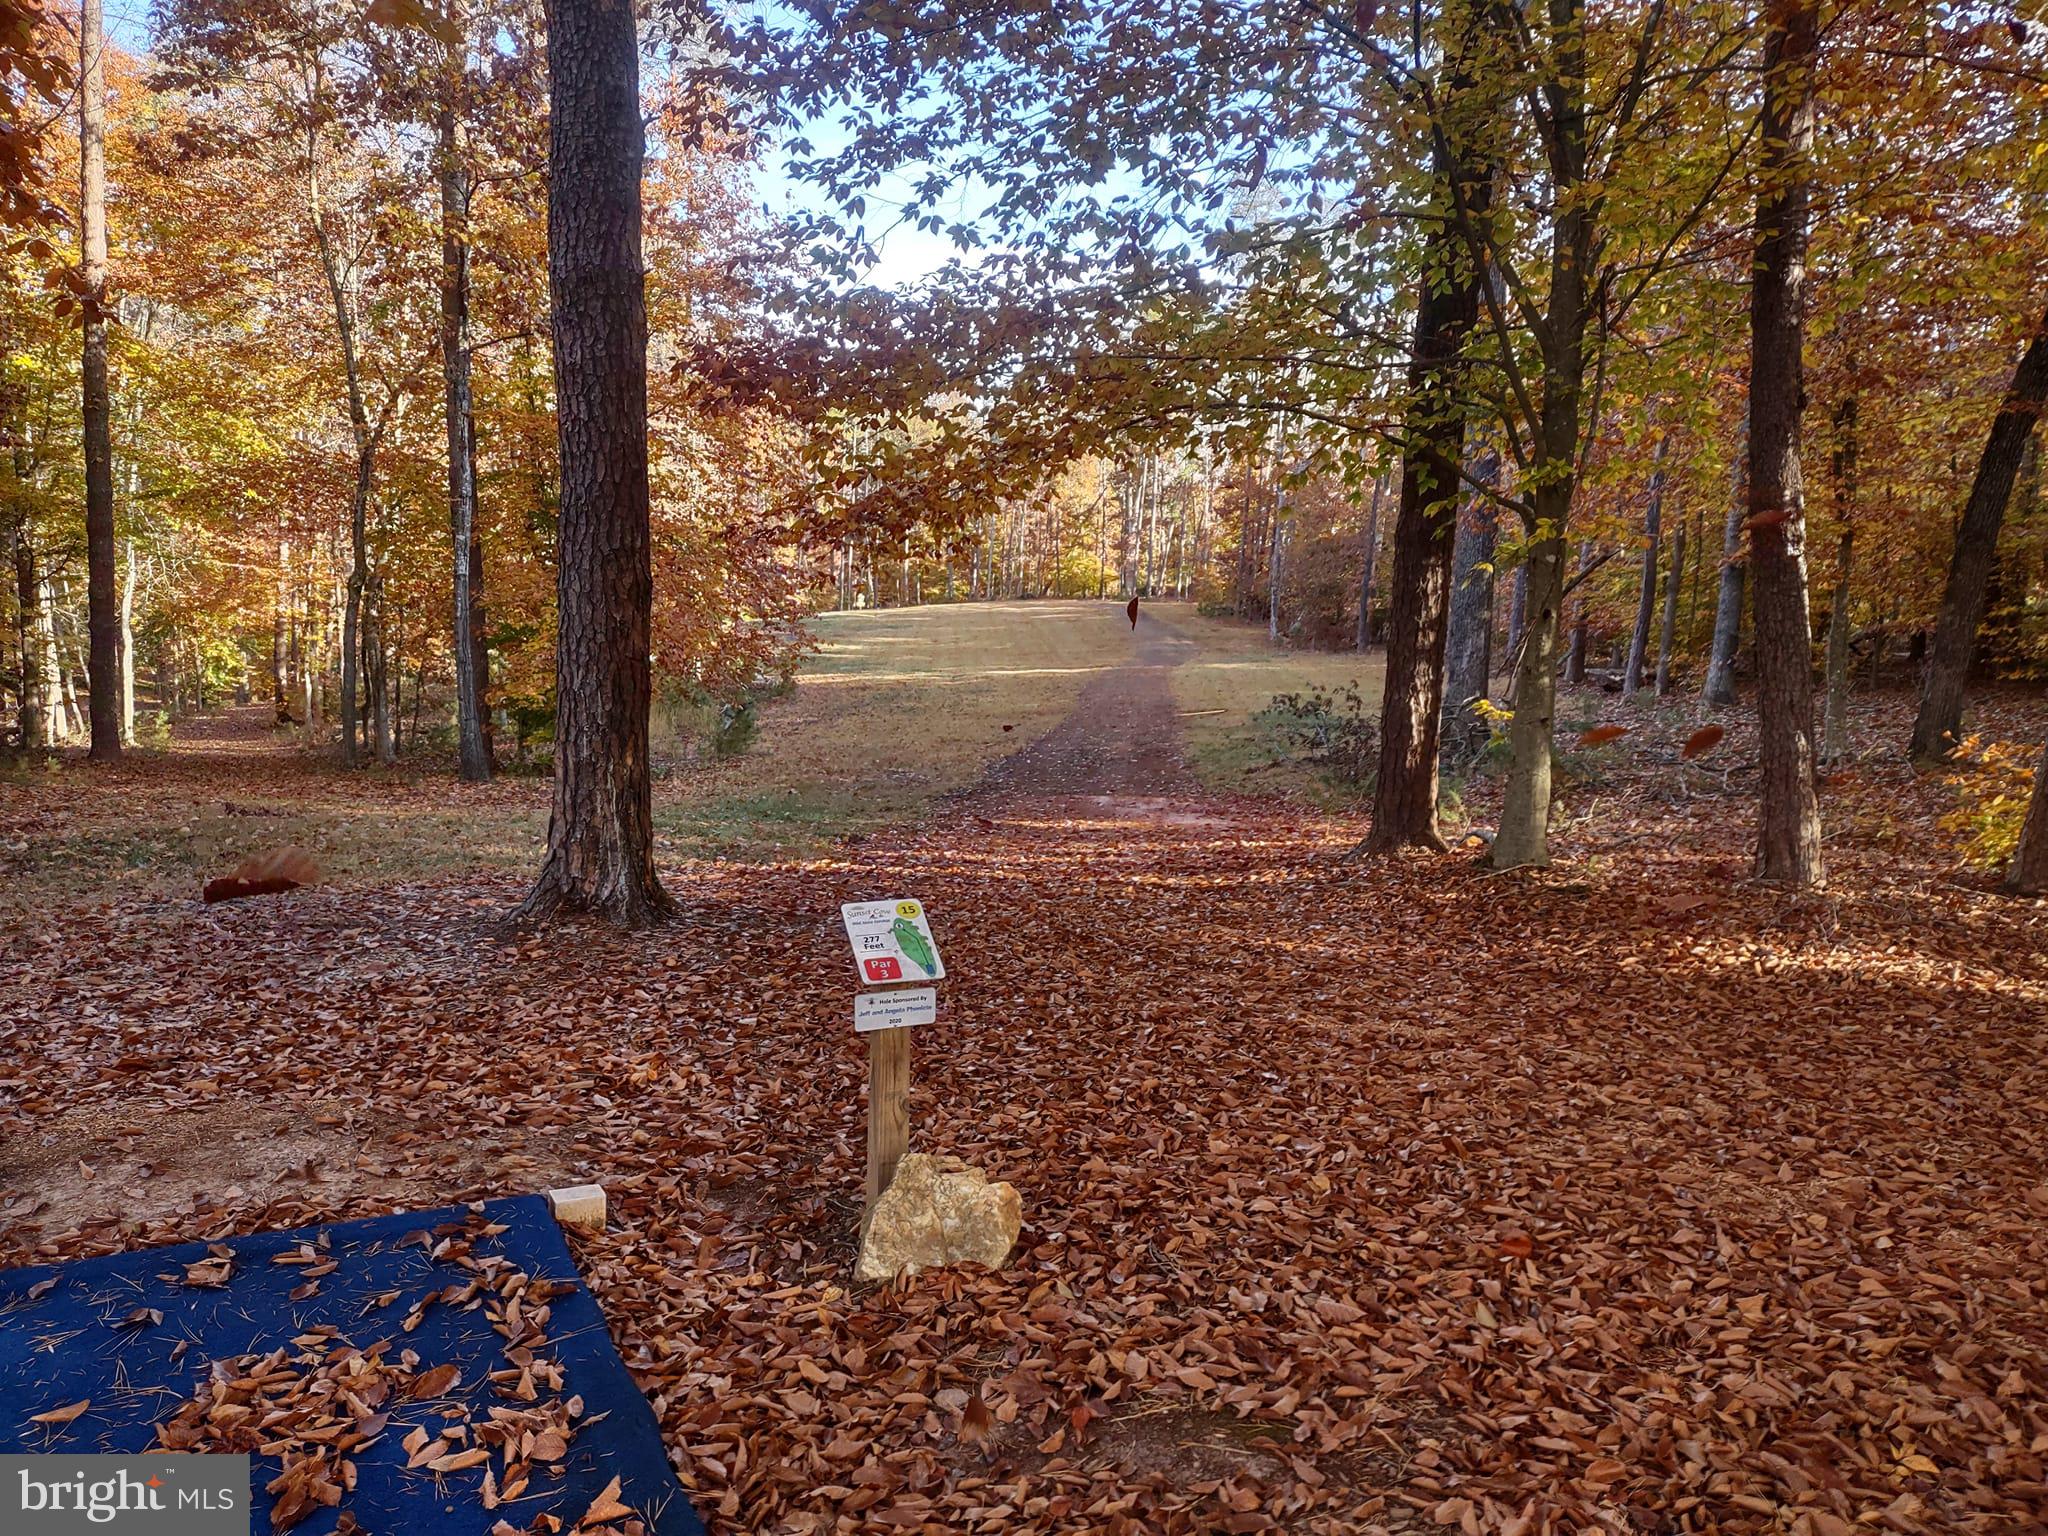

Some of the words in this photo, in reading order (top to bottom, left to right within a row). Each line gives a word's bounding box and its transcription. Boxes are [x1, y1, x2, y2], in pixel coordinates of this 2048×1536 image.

[846, 909, 871, 919] Sunset
[902, 905, 916, 914] 15
[871, 960, 891, 969] Par
[881, 970, 889, 978] 3
[892, 996, 920, 1004] Sponsored
